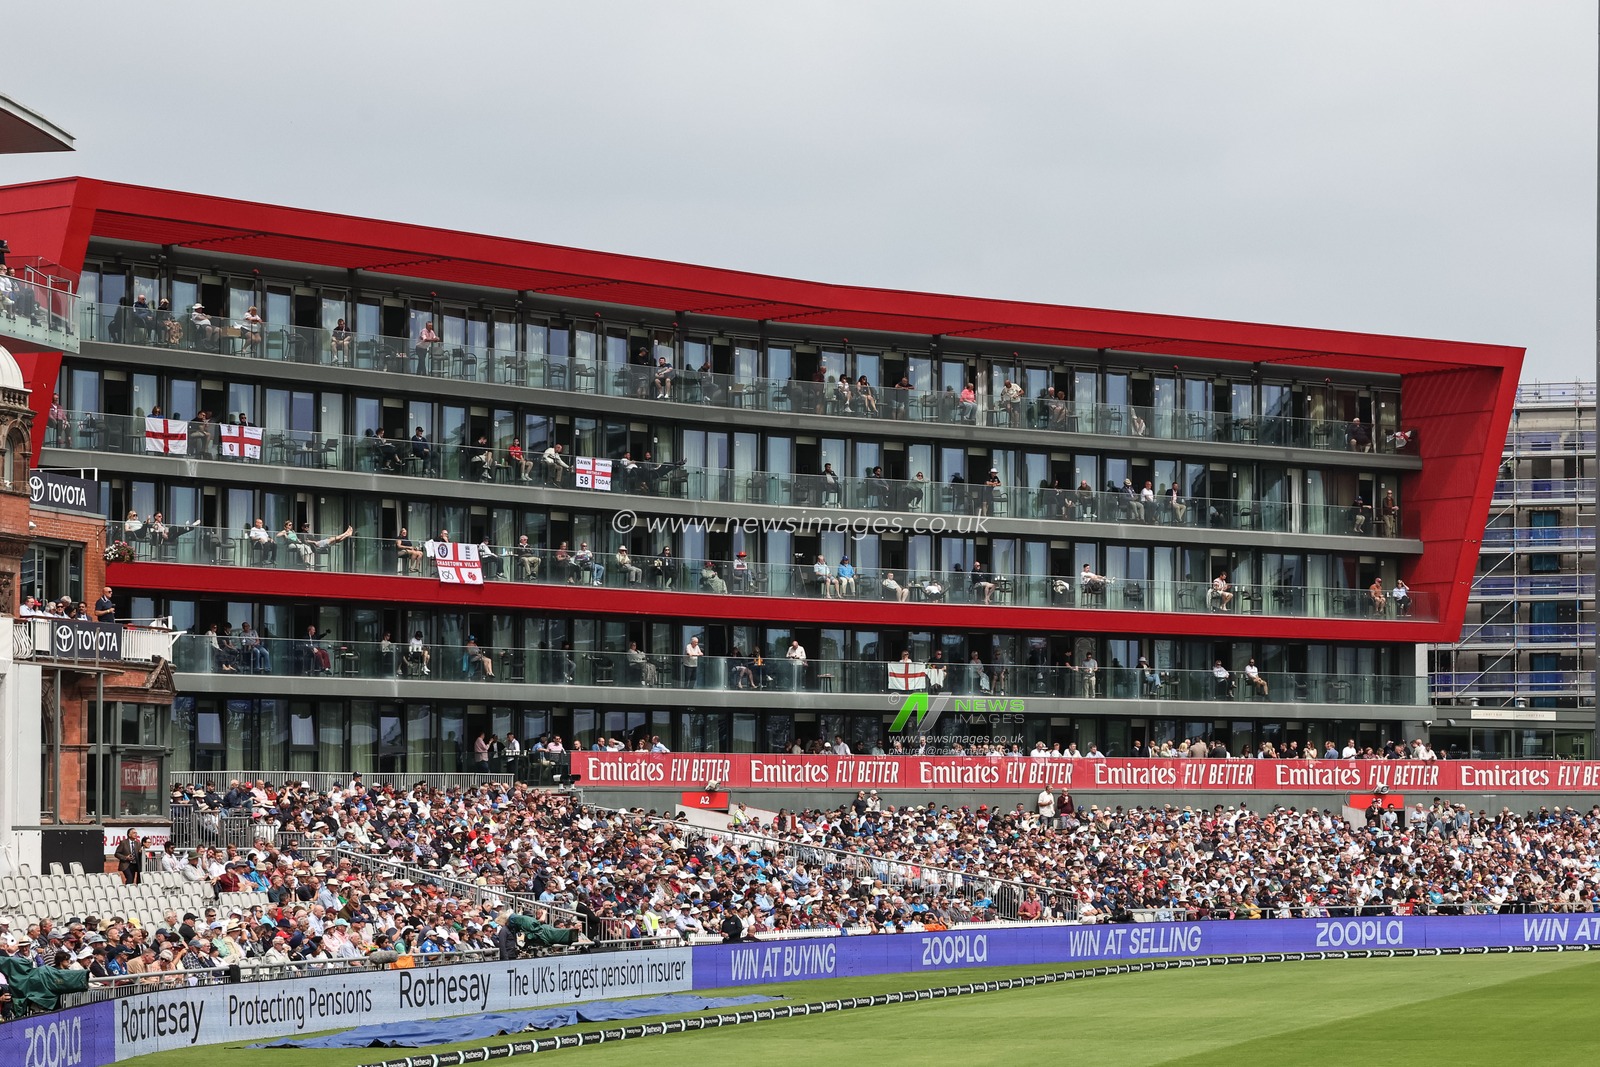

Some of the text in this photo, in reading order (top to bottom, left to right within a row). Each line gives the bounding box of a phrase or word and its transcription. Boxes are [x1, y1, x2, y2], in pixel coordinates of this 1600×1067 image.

[580, 476, 589, 485] 58
[47, 482, 87, 507] TOYOTA
[77, 629, 118, 652] TOYOTA
[587, 757, 731, 782] Emirates FLY BETTER
[751, 759, 900, 783] Emirates FLY BETTER
[919, 761, 1074, 784] Emirates FLY BETTER
[1094, 763, 1254, 785] Emirates FLY BETTER
[1275, 764, 1439, 786] Emirates FLY BETTER
[1460, 765, 1550, 786] Emirates
[1557, 766, 1581, 786] FLY
[700, 796, 710, 805] A2
[110, 835, 141, 847] JAS
[1069, 925, 1202, 957] WIN AT SELLING
[1523, 917, 1600, 942] WIN AT
[731, 942, 836, 981] WIN AT BUYING
[121, 957, 686, 1045] Rothesay Protecting Pensions Rothesay The UK's largest pension insurer
